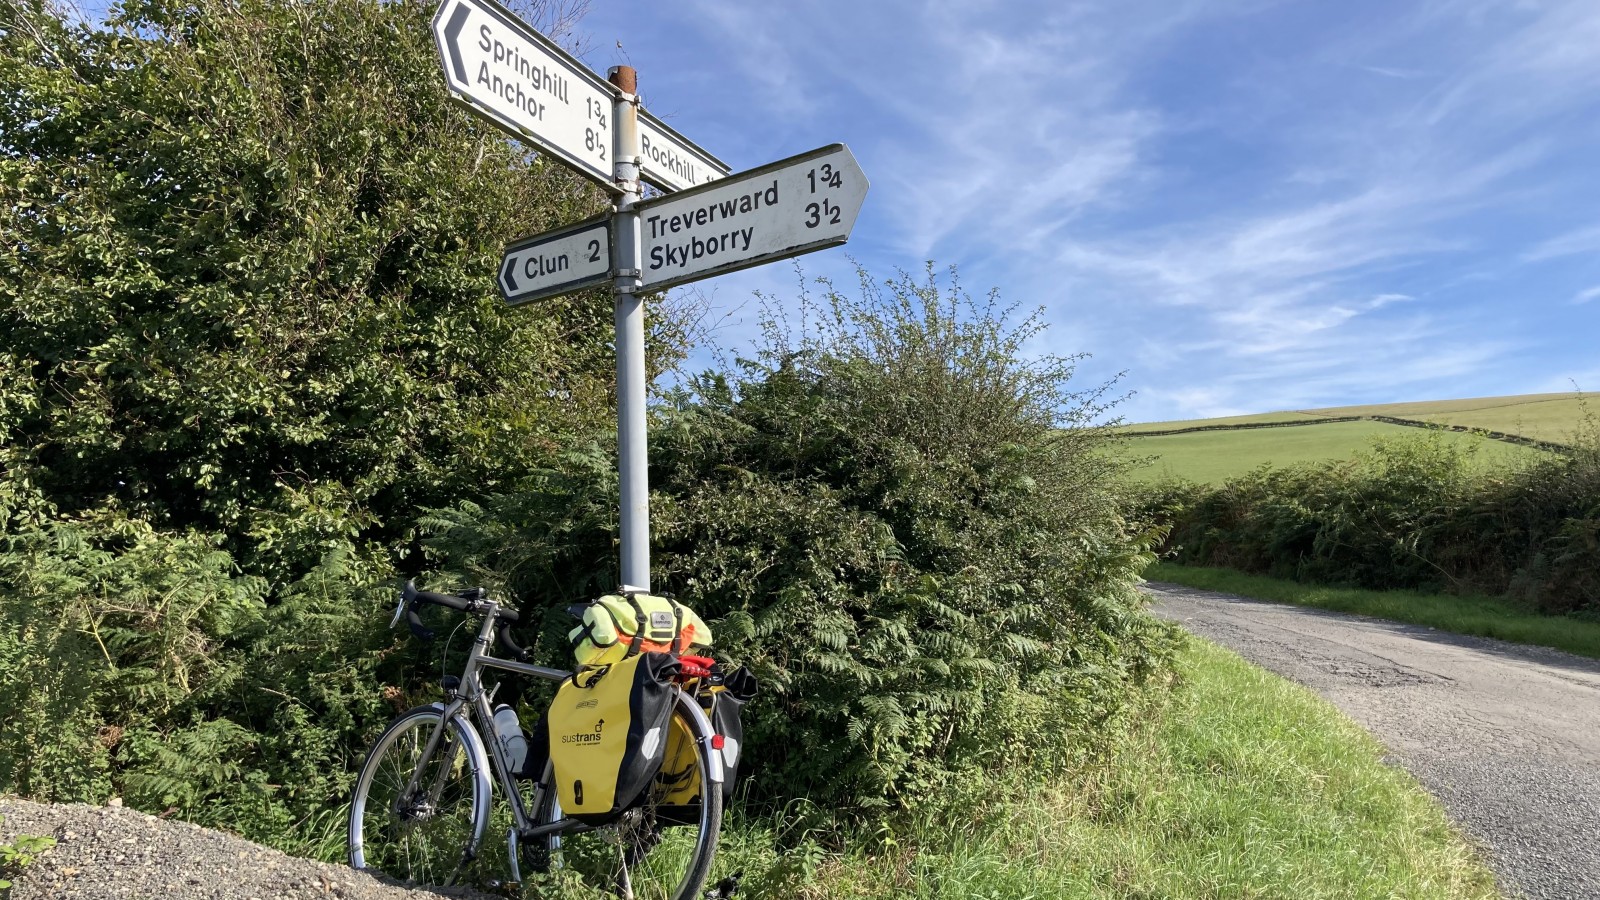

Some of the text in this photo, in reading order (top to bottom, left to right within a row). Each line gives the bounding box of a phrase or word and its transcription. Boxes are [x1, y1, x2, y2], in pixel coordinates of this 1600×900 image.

[478, 24, 569, 105] Springhill
[477, 62, 546, 121] Anchor
[641, 133, 696, 186] Rockhill
[647, 180, 779, 239] Treverward
[524, 239, 601, 280] Clun 2
[649, 226, 754, 270] Skyborry
[561, 733, 602, 743] sustrans
